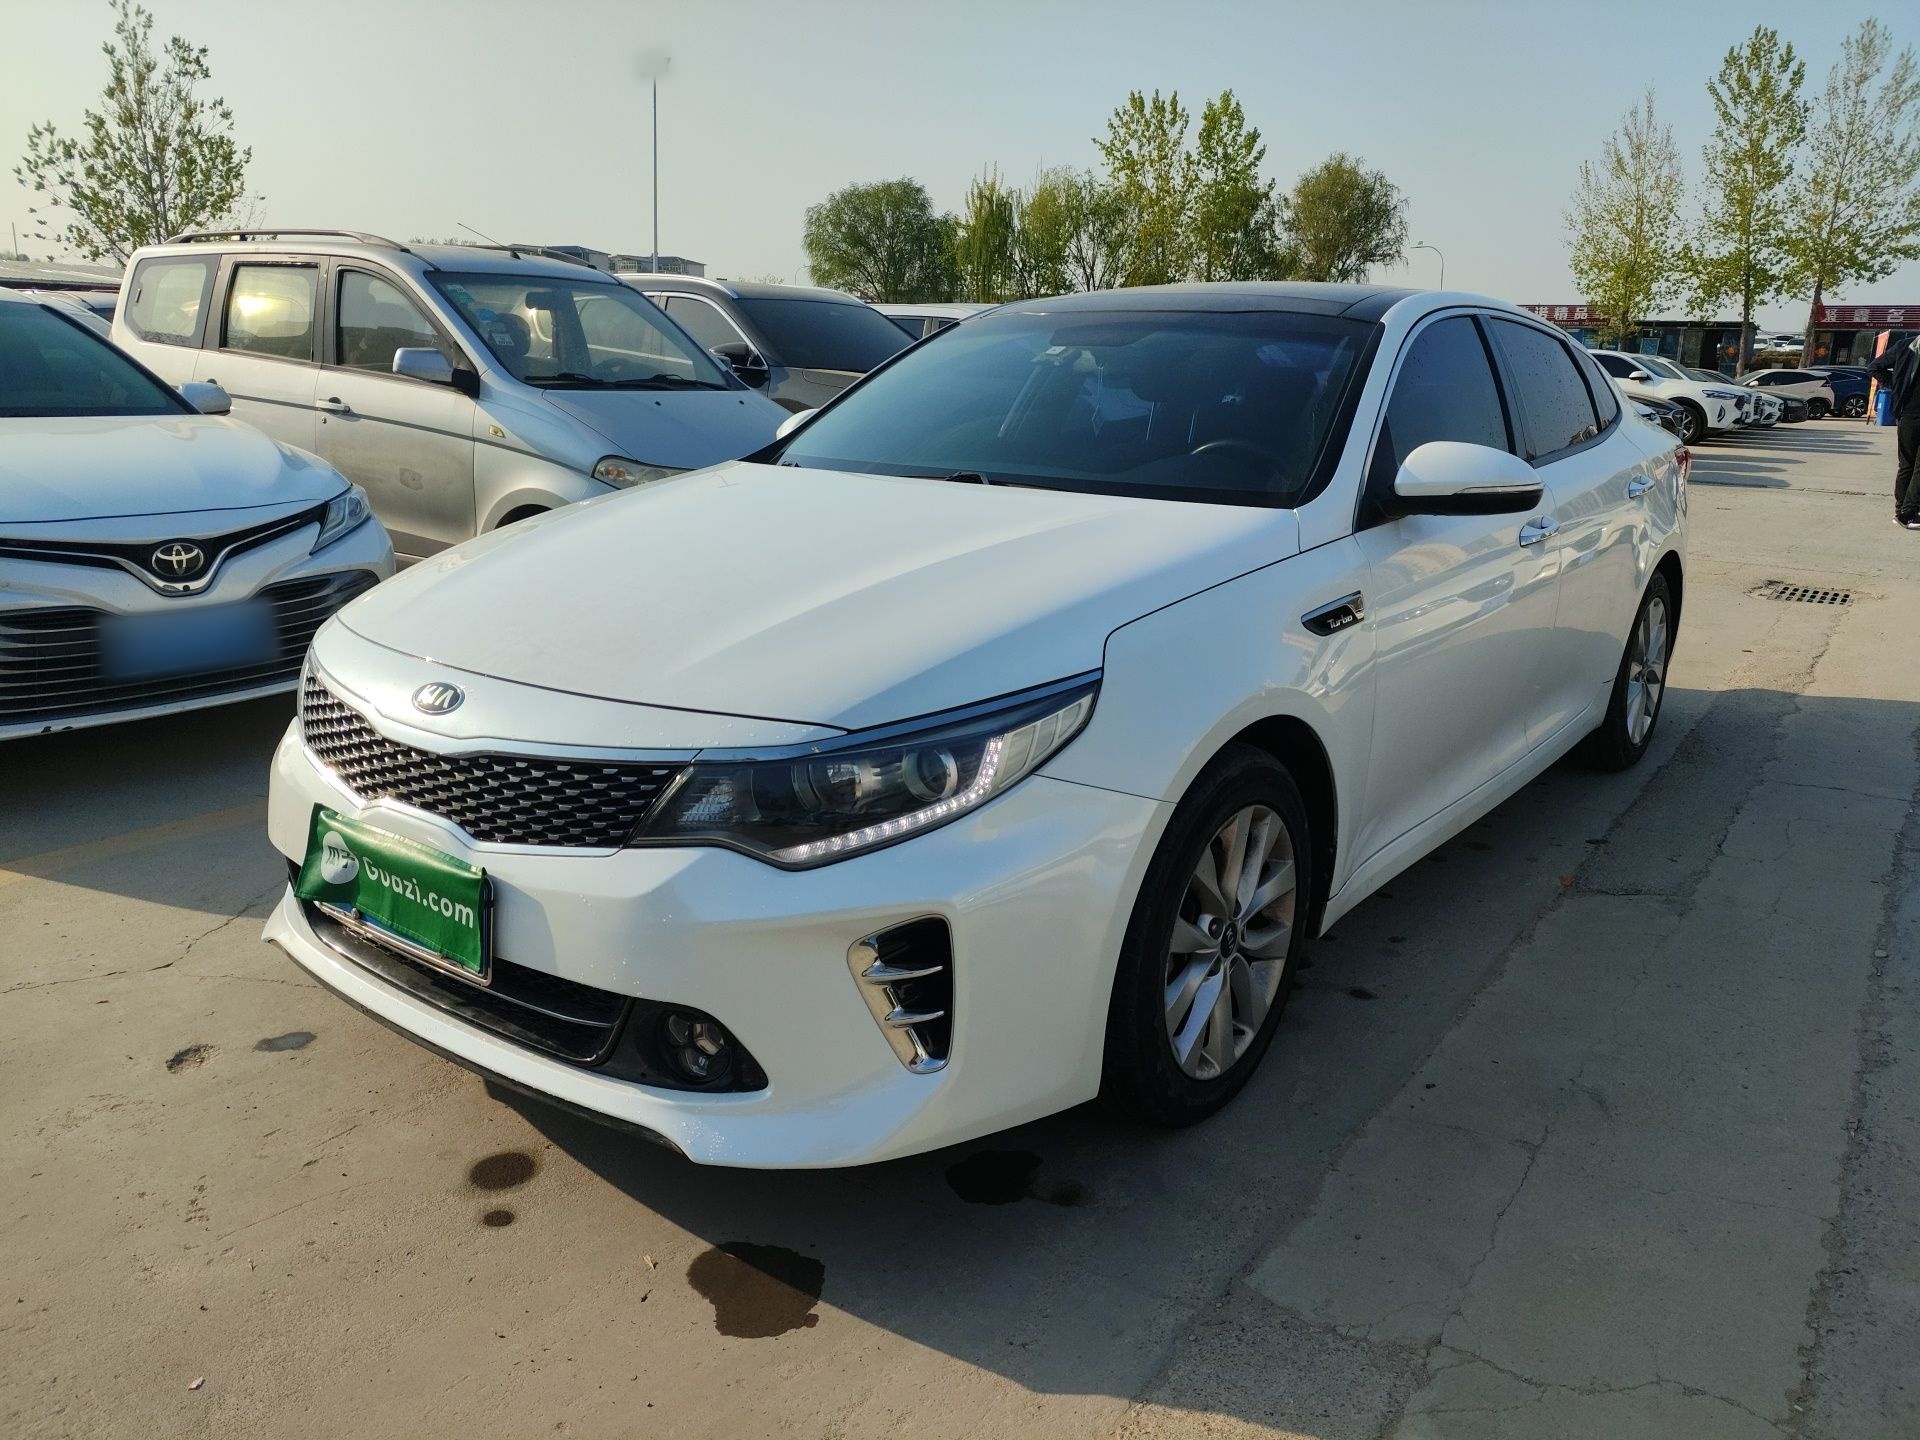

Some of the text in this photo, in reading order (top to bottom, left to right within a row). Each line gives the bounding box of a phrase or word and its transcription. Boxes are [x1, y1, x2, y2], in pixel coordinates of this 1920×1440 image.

[1327, 614, 1353, 629] Turbo
[417, 684, 455, 709] KIA
[362, 856, 474, 929] Guazi.com
